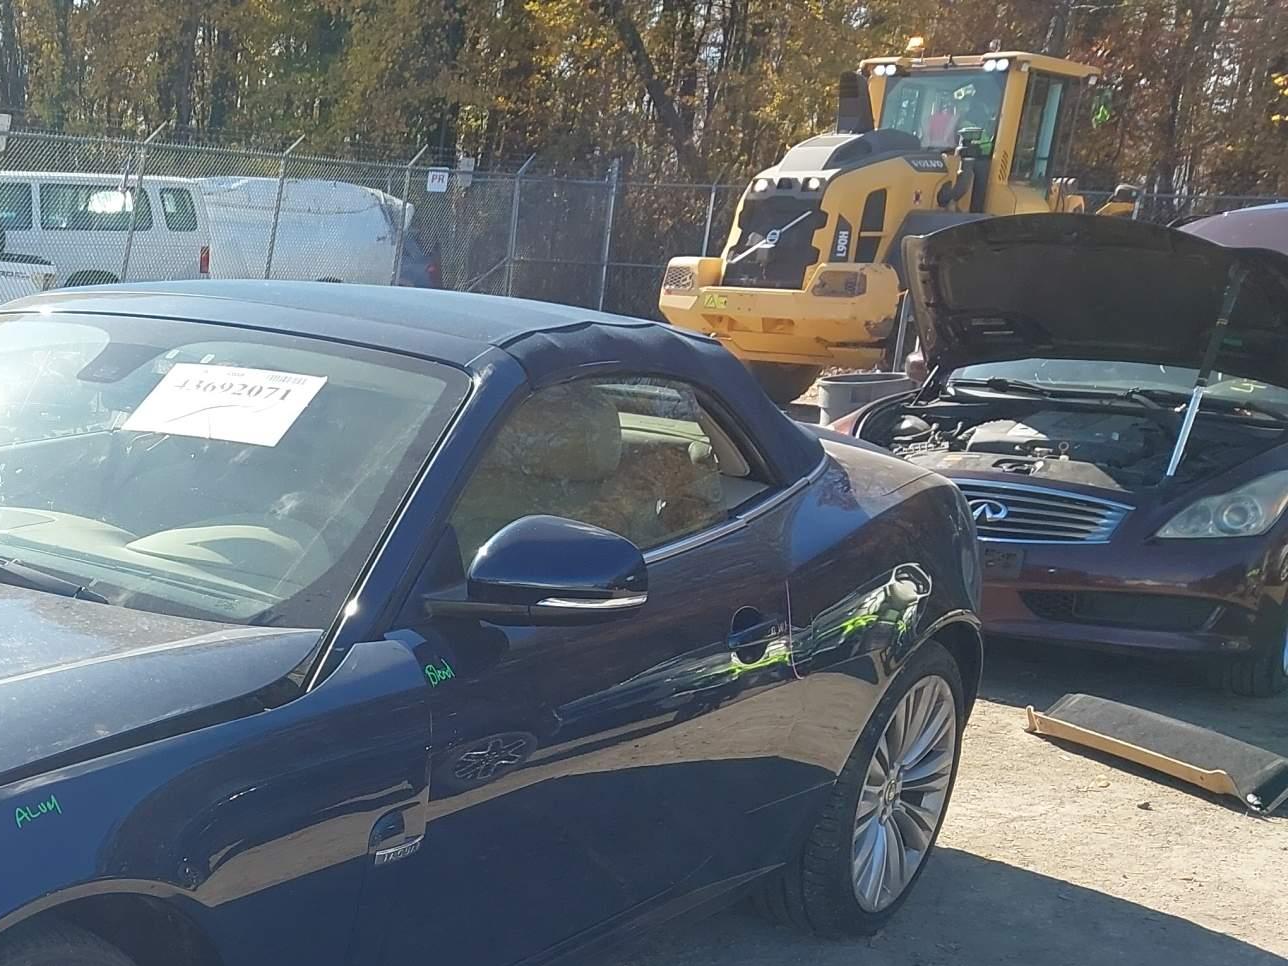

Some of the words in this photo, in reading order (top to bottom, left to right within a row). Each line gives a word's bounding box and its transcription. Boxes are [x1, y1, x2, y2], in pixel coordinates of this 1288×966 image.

[911, 160, 944, 168] VOLVO
[432, 174, 445, 183] PR
[836, 231, 849, 257] L90H
[15, 794, 62, 828] ALUM
